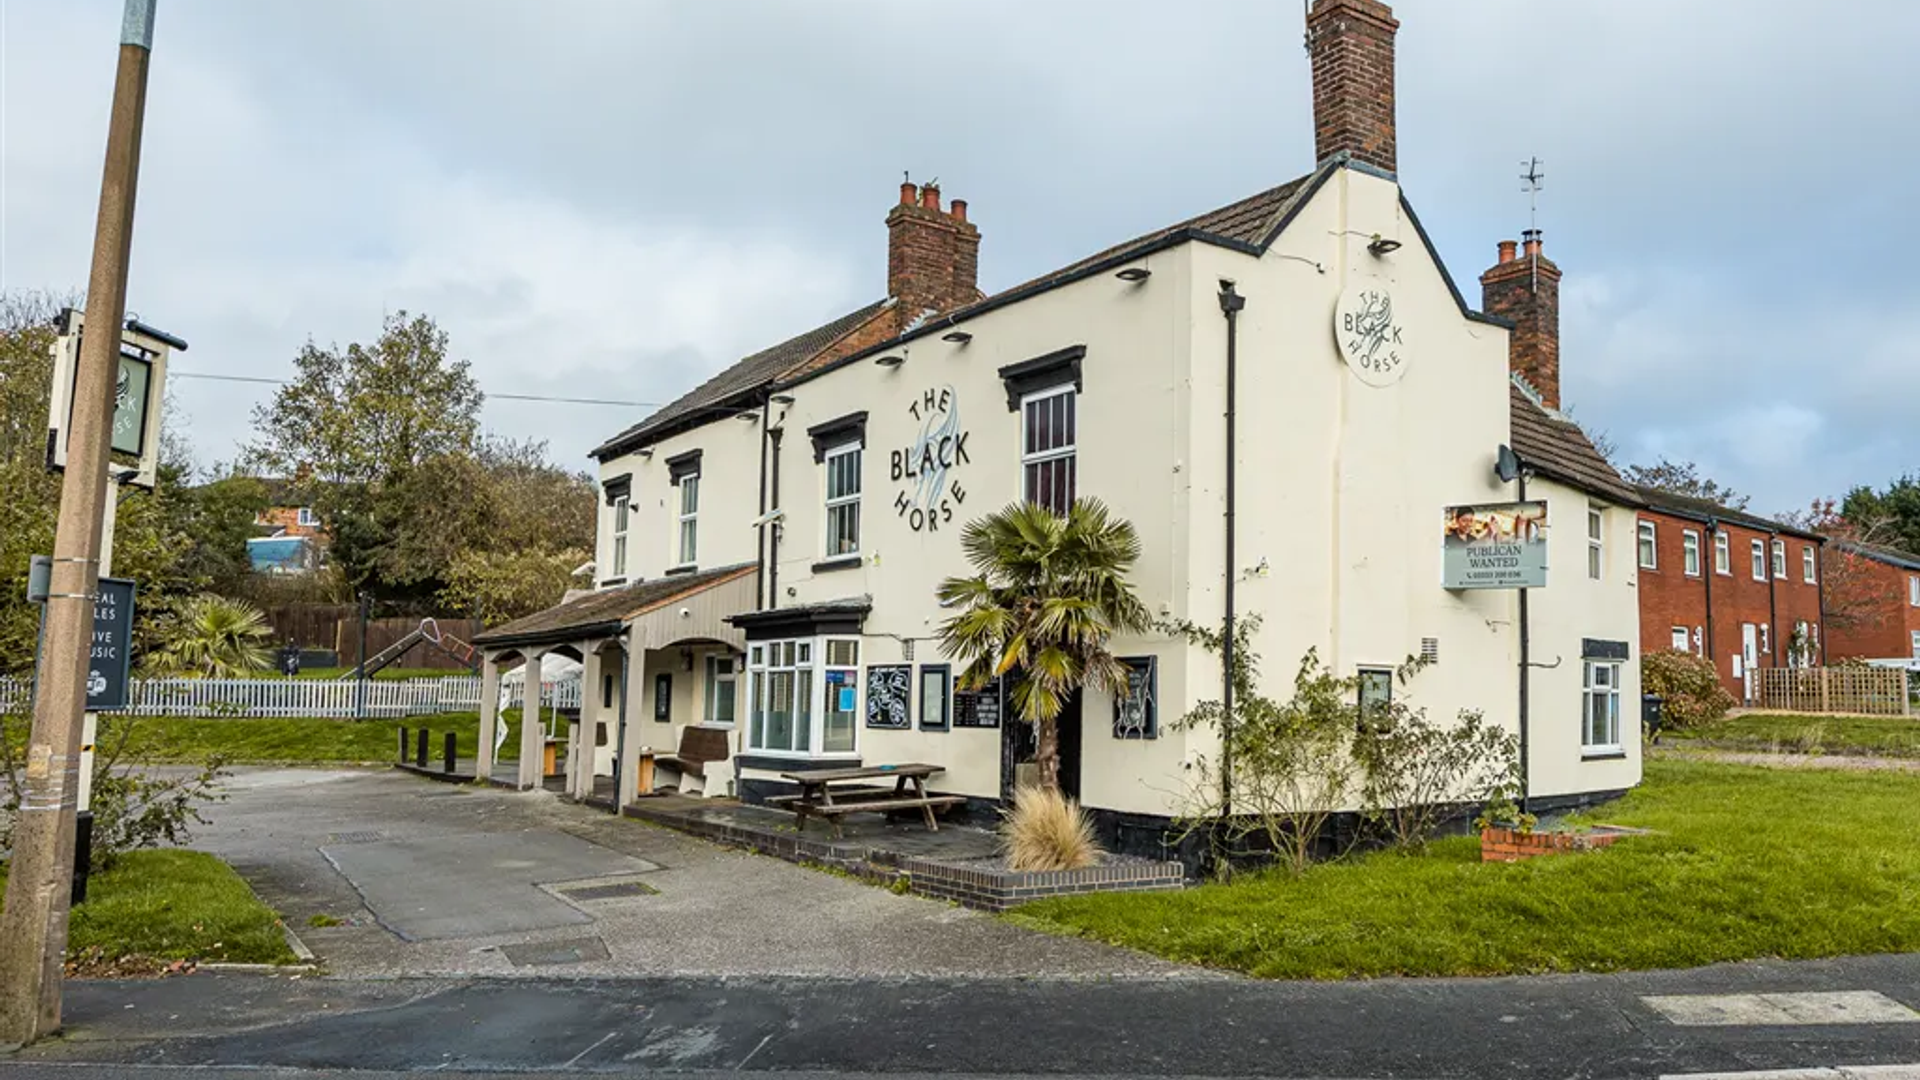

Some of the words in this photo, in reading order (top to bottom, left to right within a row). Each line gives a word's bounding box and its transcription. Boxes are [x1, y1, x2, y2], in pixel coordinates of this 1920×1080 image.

[1359, 291, 1390, 308] THE
[1345, 312, 1403, 345] BLACK
[1348, 340, 1400, 372] HORSE
[909, 388, 950, 421] THE
[891, 431, 970, 481] BLACK
[894, 480, 966, 532] HORSE
[1466, 545, 1521, 558] PUBLICAN
[1469, 557, 1519, 568] WANTED
[95, 592, 116, 604] EAL
[94, 608, 115, 620] LES
[92, 632, 112, 642] IVE
[90, 647, 116, 658] USIC
